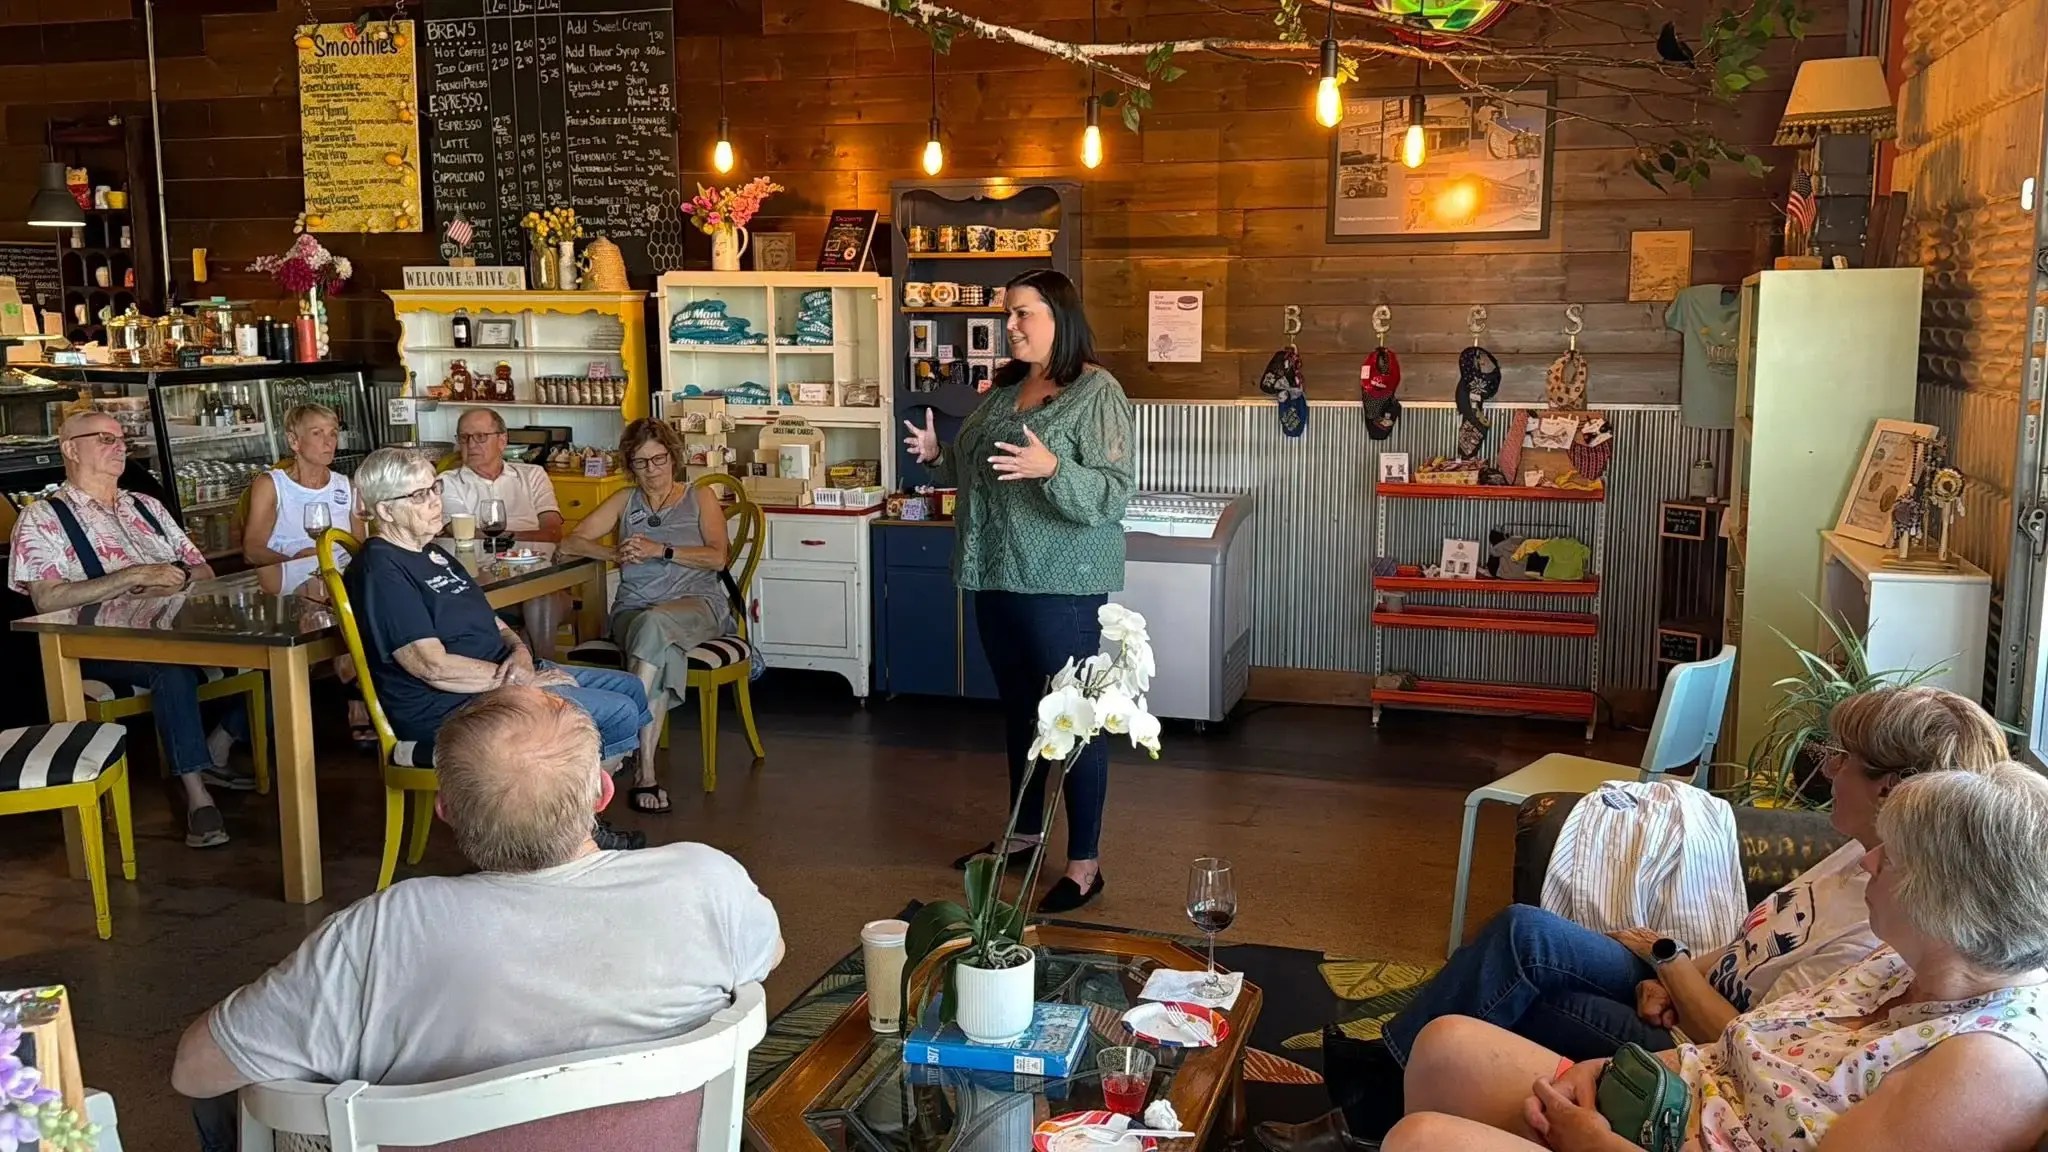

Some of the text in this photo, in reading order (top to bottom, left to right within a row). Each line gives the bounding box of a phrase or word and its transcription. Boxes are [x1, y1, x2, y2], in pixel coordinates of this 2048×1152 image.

[427, 22, 476, 40] BREWS
[566, 18, 652, 34] Add Sweet Cream
[314, 32, 398, 57] Smoothies
[566, 44, 584, 58] Add
[616, 44, 640, 60] Syrup
[626, 86, 644, 96] Oat
[429, 92, 482, 112] ESPRESSO
[438, 119, 482, 130] ESPRESSO
[440, 138, 469, 149] LATTE
[434, 185, 468, 198] BREVE
[406, 271, 461, 286] WELCOME
[476, 270, 504, 286] HIVE
